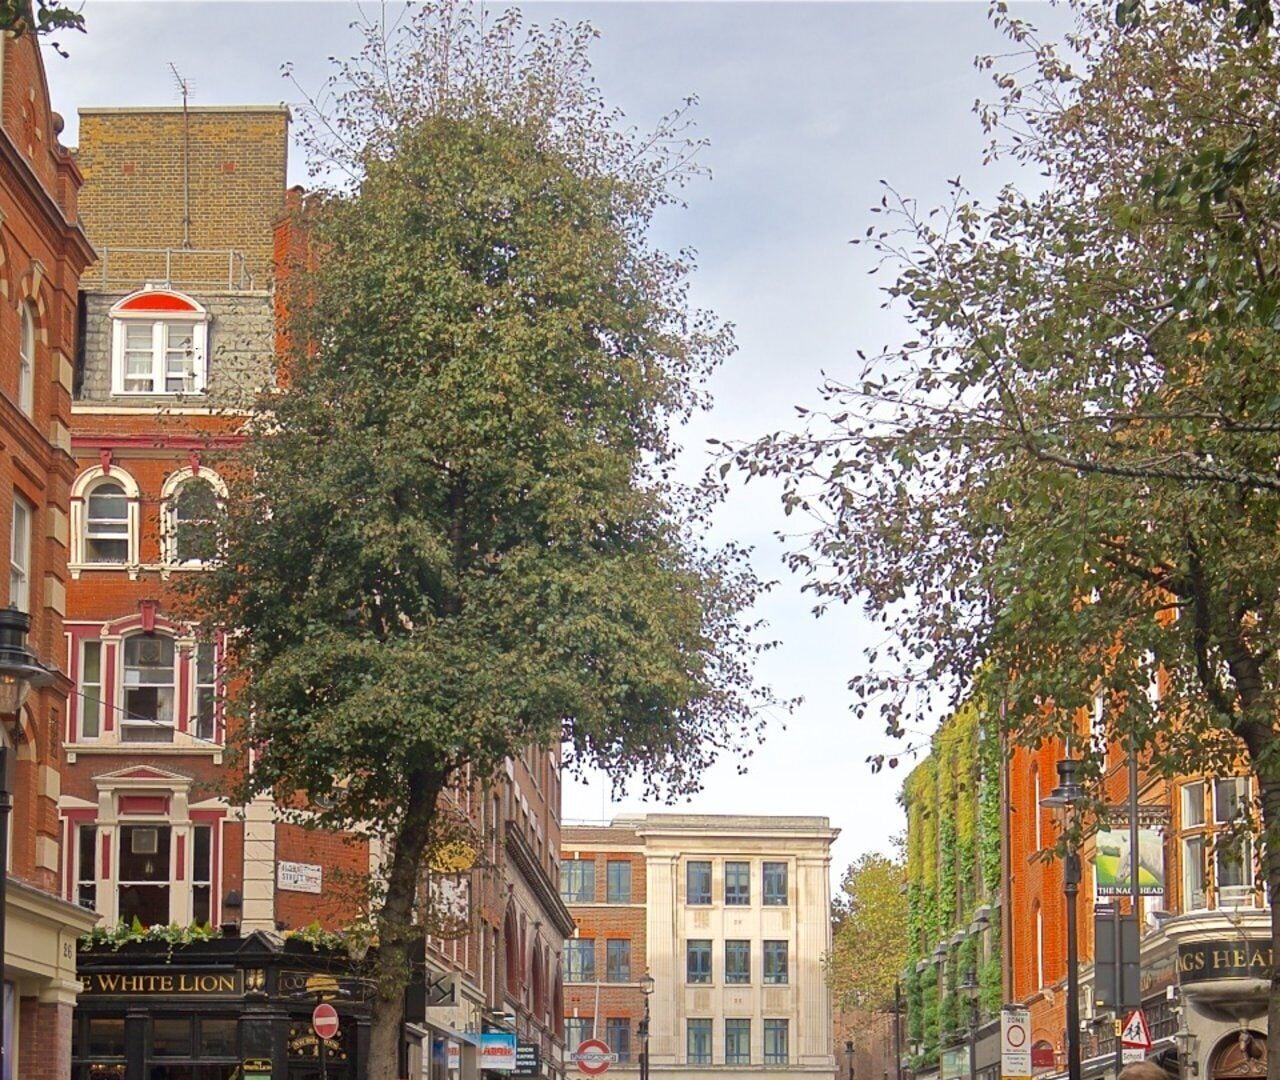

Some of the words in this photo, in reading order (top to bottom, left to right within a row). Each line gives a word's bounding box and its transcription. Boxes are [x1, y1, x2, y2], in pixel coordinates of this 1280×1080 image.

[1212, 949, 1272, 969] HEA
[96, 974, 174, 992] WHITE
[178, 974, 235, 992] LION
[1123, 1052, 1143, 1060] School
